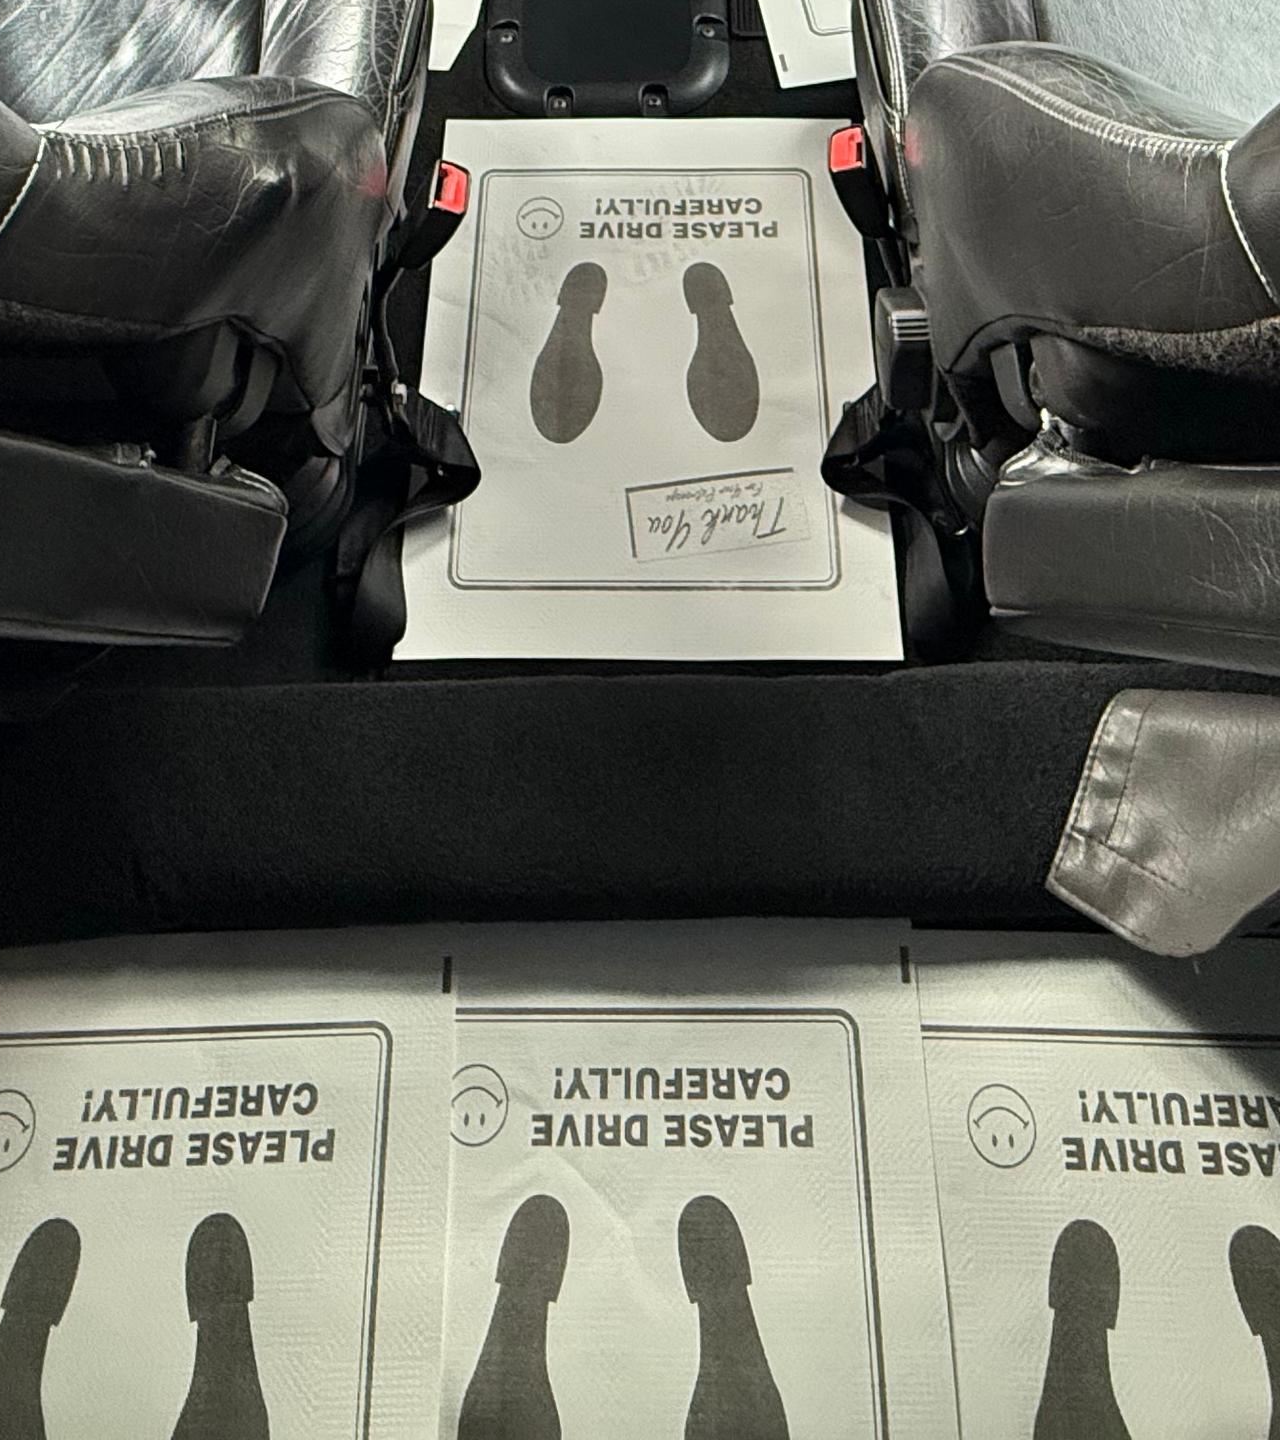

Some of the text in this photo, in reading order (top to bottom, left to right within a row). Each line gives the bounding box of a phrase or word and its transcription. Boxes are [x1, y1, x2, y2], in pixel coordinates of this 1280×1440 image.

[595, 197, 763, 217] CAREFULLY!
[579, 221, 778, 239] PLEASE DRIVE
[647, 497, 787, 553] Thank You
[553, 1067, 791, 1101] CAREFULLY!
[81, 1082, 319, 1123] CAREFULLY!
[531, 1113, 814, 1148] PLEASE DRIVE
[52, 1129, 336, 1171] PLEASE DRIVE
[1061, 1136, 1186, 1174] DRIVE
